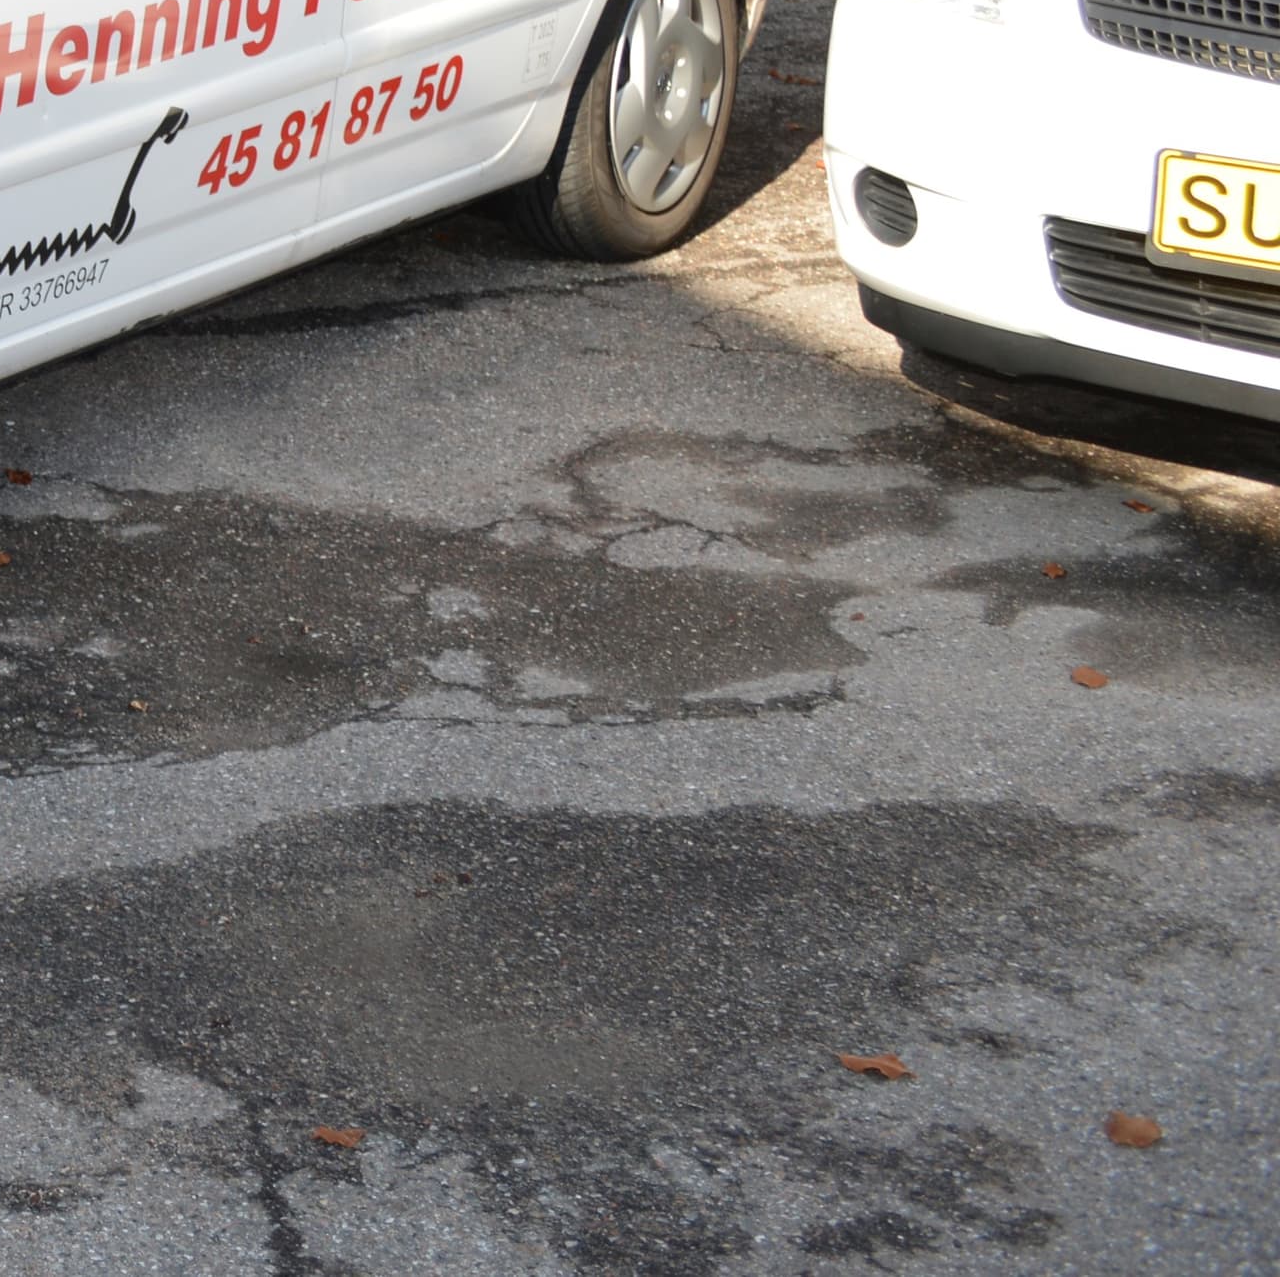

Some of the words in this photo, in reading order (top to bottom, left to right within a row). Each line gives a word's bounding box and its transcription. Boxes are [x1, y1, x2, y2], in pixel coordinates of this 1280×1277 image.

[197, 124, 262, 196] 45
[273, 100, 331, 171] 81
[342, 75, 402, 145] 87
[409, 54, 464, 122] 50
[1177, 175, 1280, 248] SU
[19, 257, 109, 314] 33766947
